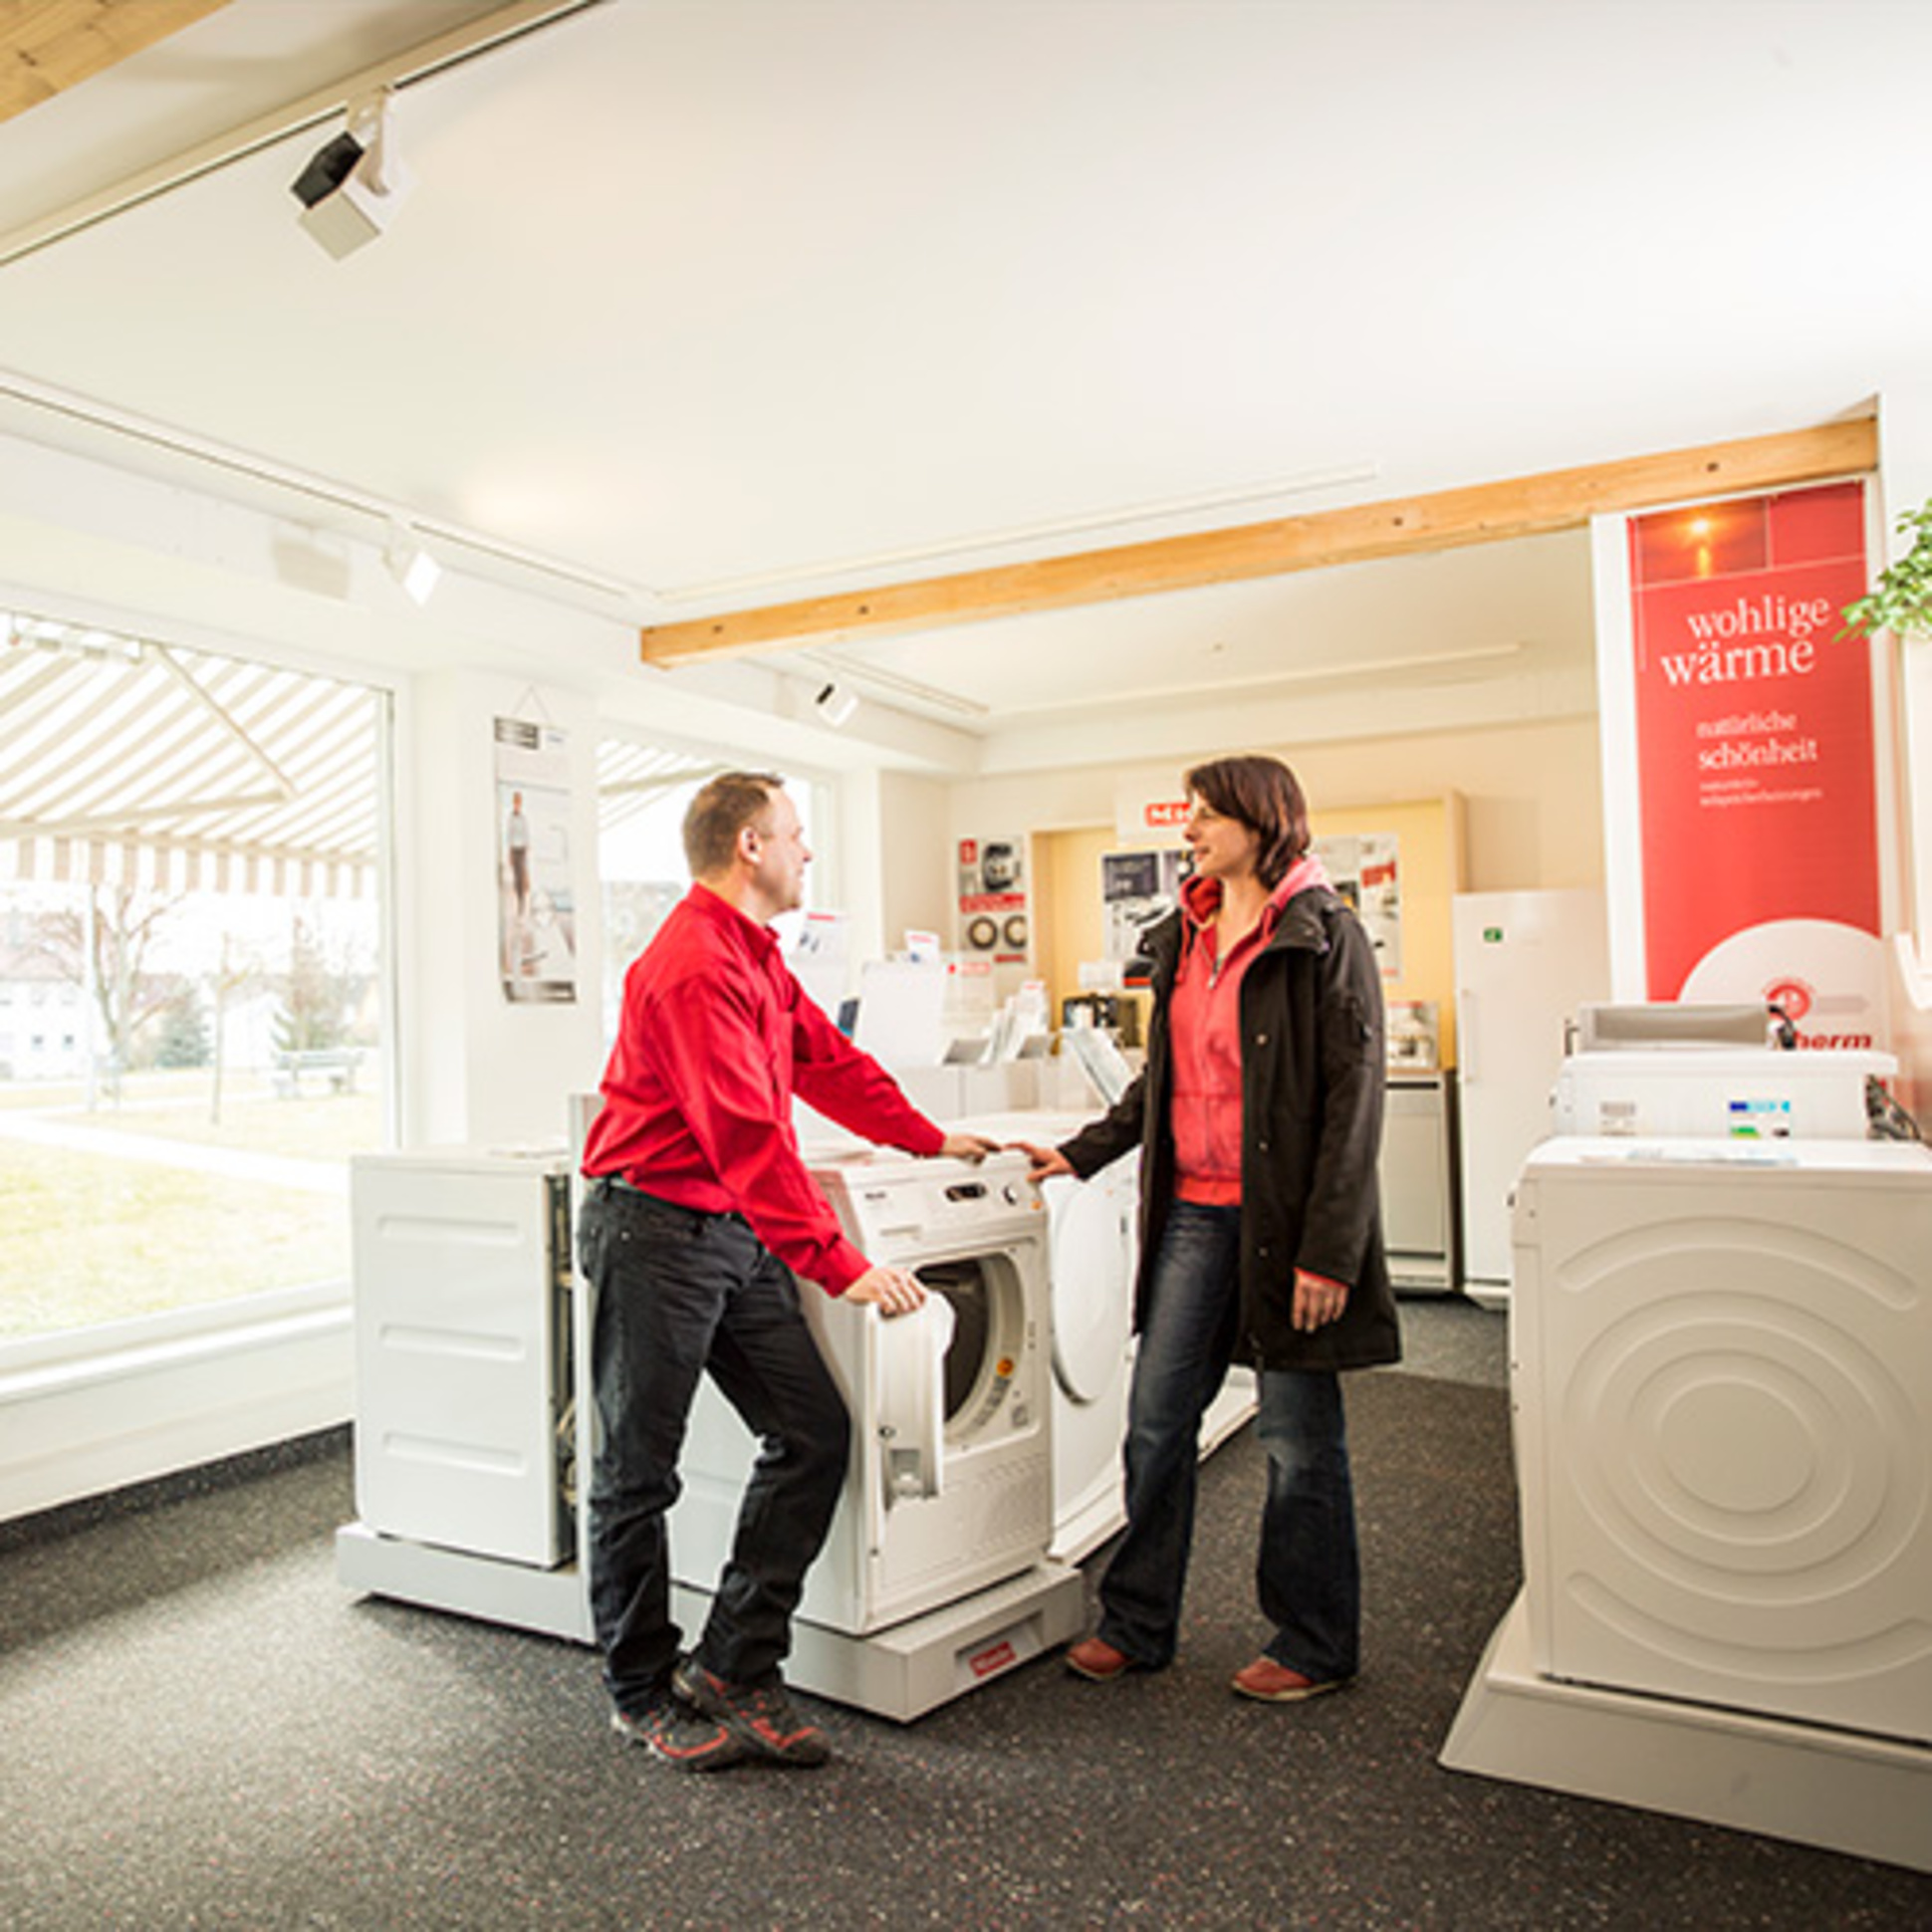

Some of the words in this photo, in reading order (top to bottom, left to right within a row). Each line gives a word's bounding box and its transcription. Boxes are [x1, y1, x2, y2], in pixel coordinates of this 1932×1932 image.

[1687, 595, 1829, 638] wohlige
[1660, 639, 1815, 685] wärme
[1794, 1030, 1871, 1050] herm
